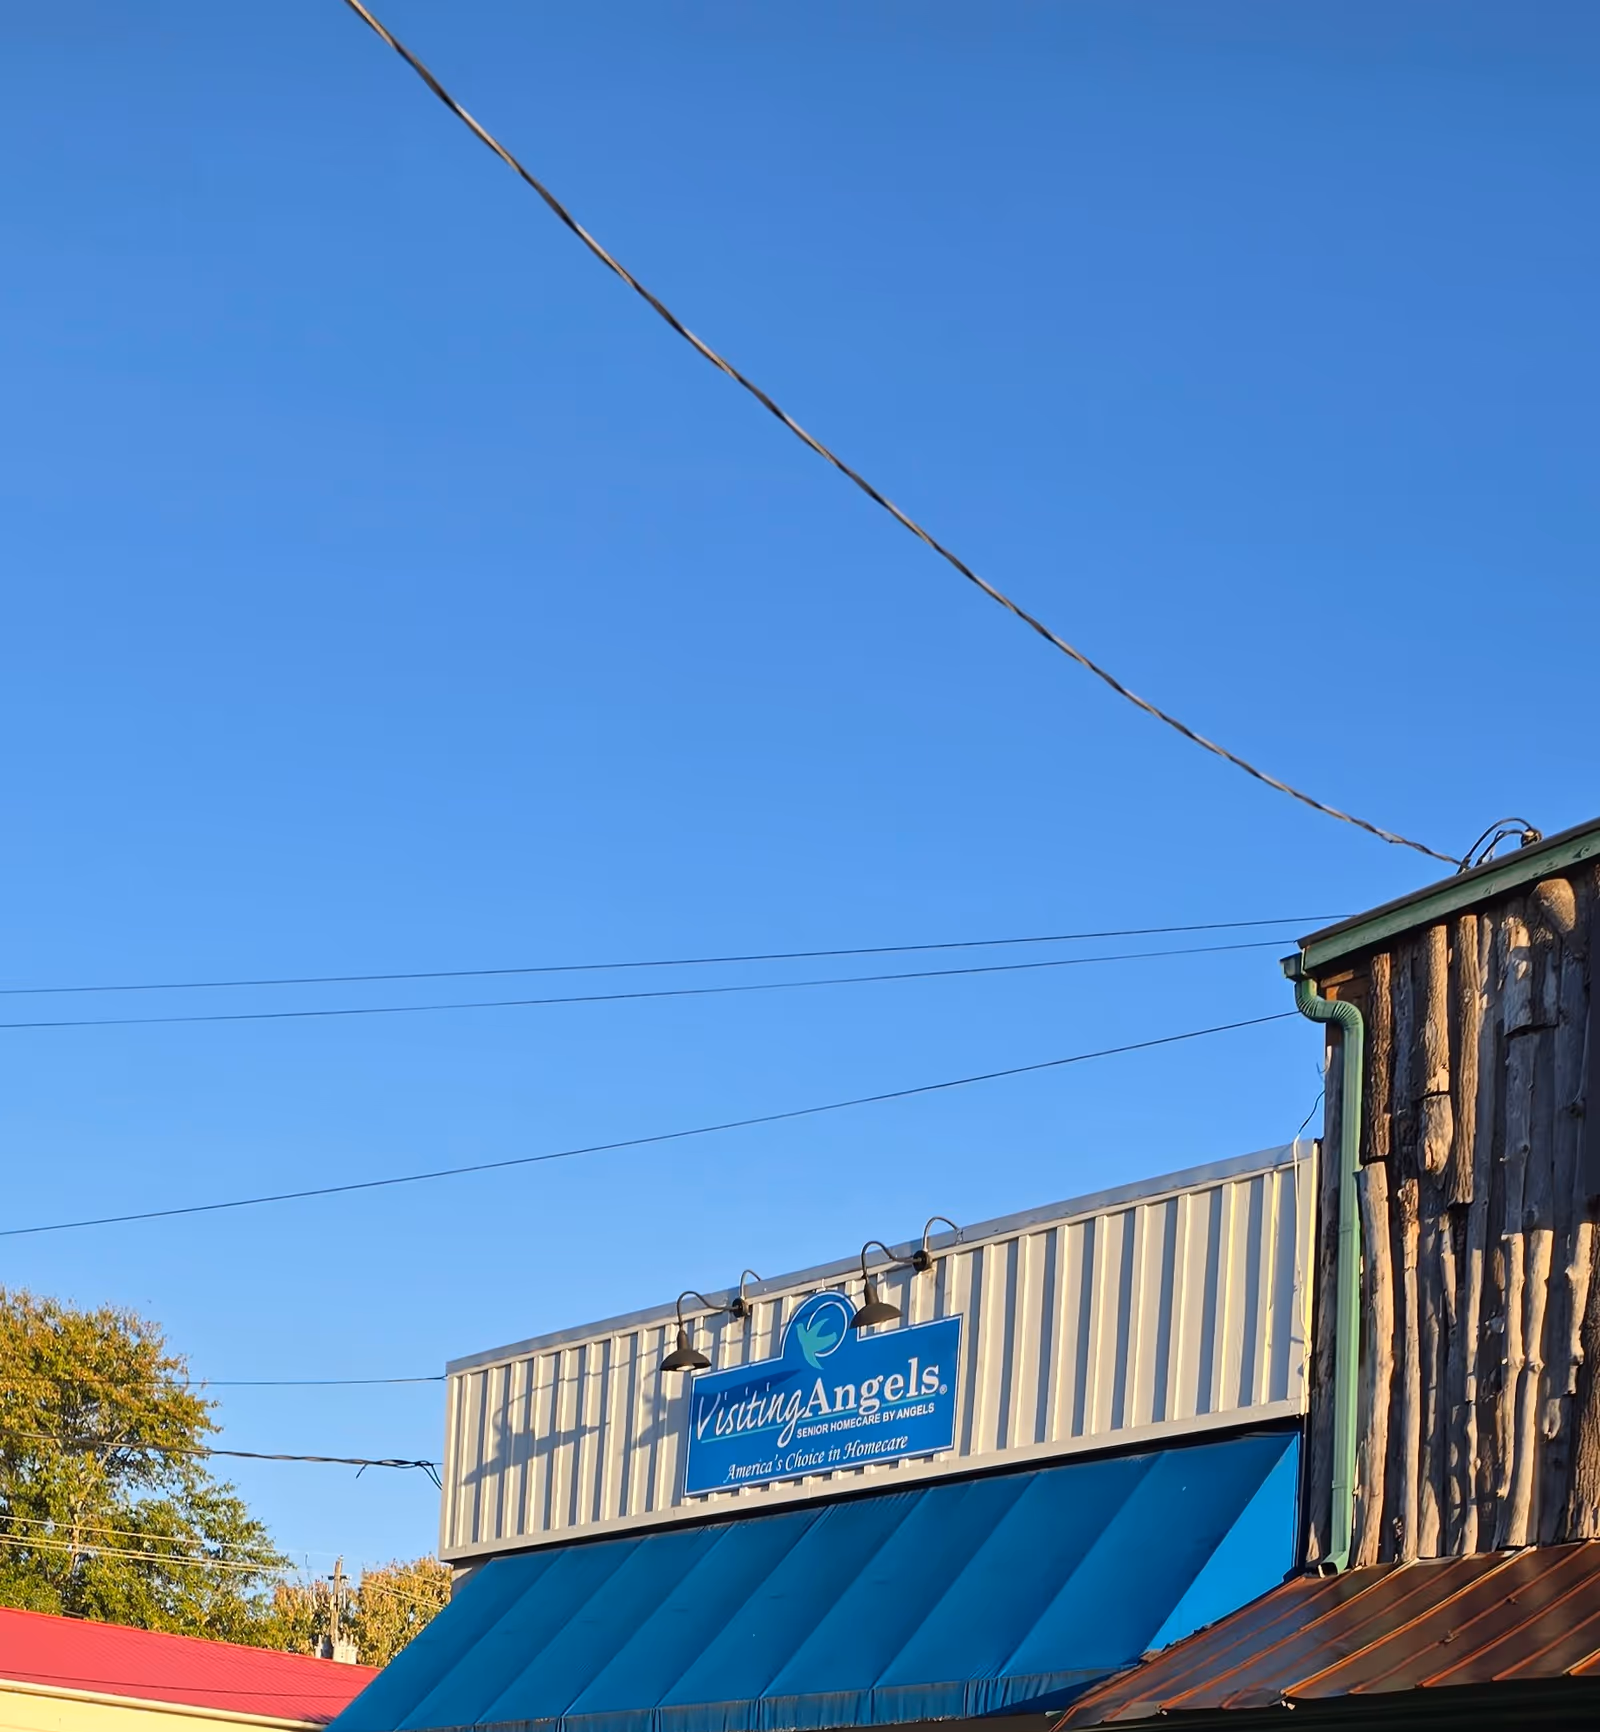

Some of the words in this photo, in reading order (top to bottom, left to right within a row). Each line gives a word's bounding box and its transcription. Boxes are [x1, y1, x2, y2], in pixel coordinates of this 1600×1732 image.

[697, 1382, 806, 1448] Visiting
[796, 1424, 829, 1439] SENIOR
[830, 1413, 881, 1432] HOMECARE
[882, 1409, 896, 1423] BY
[896, 1402, 935, 1420] ANGELS
[723, 1454, 783, 1484] America's
[785, 1448, 825, 1472] Choice
[827, 1445, 841, 1461] in
[843, 1435, 908, 1460] Homecare
